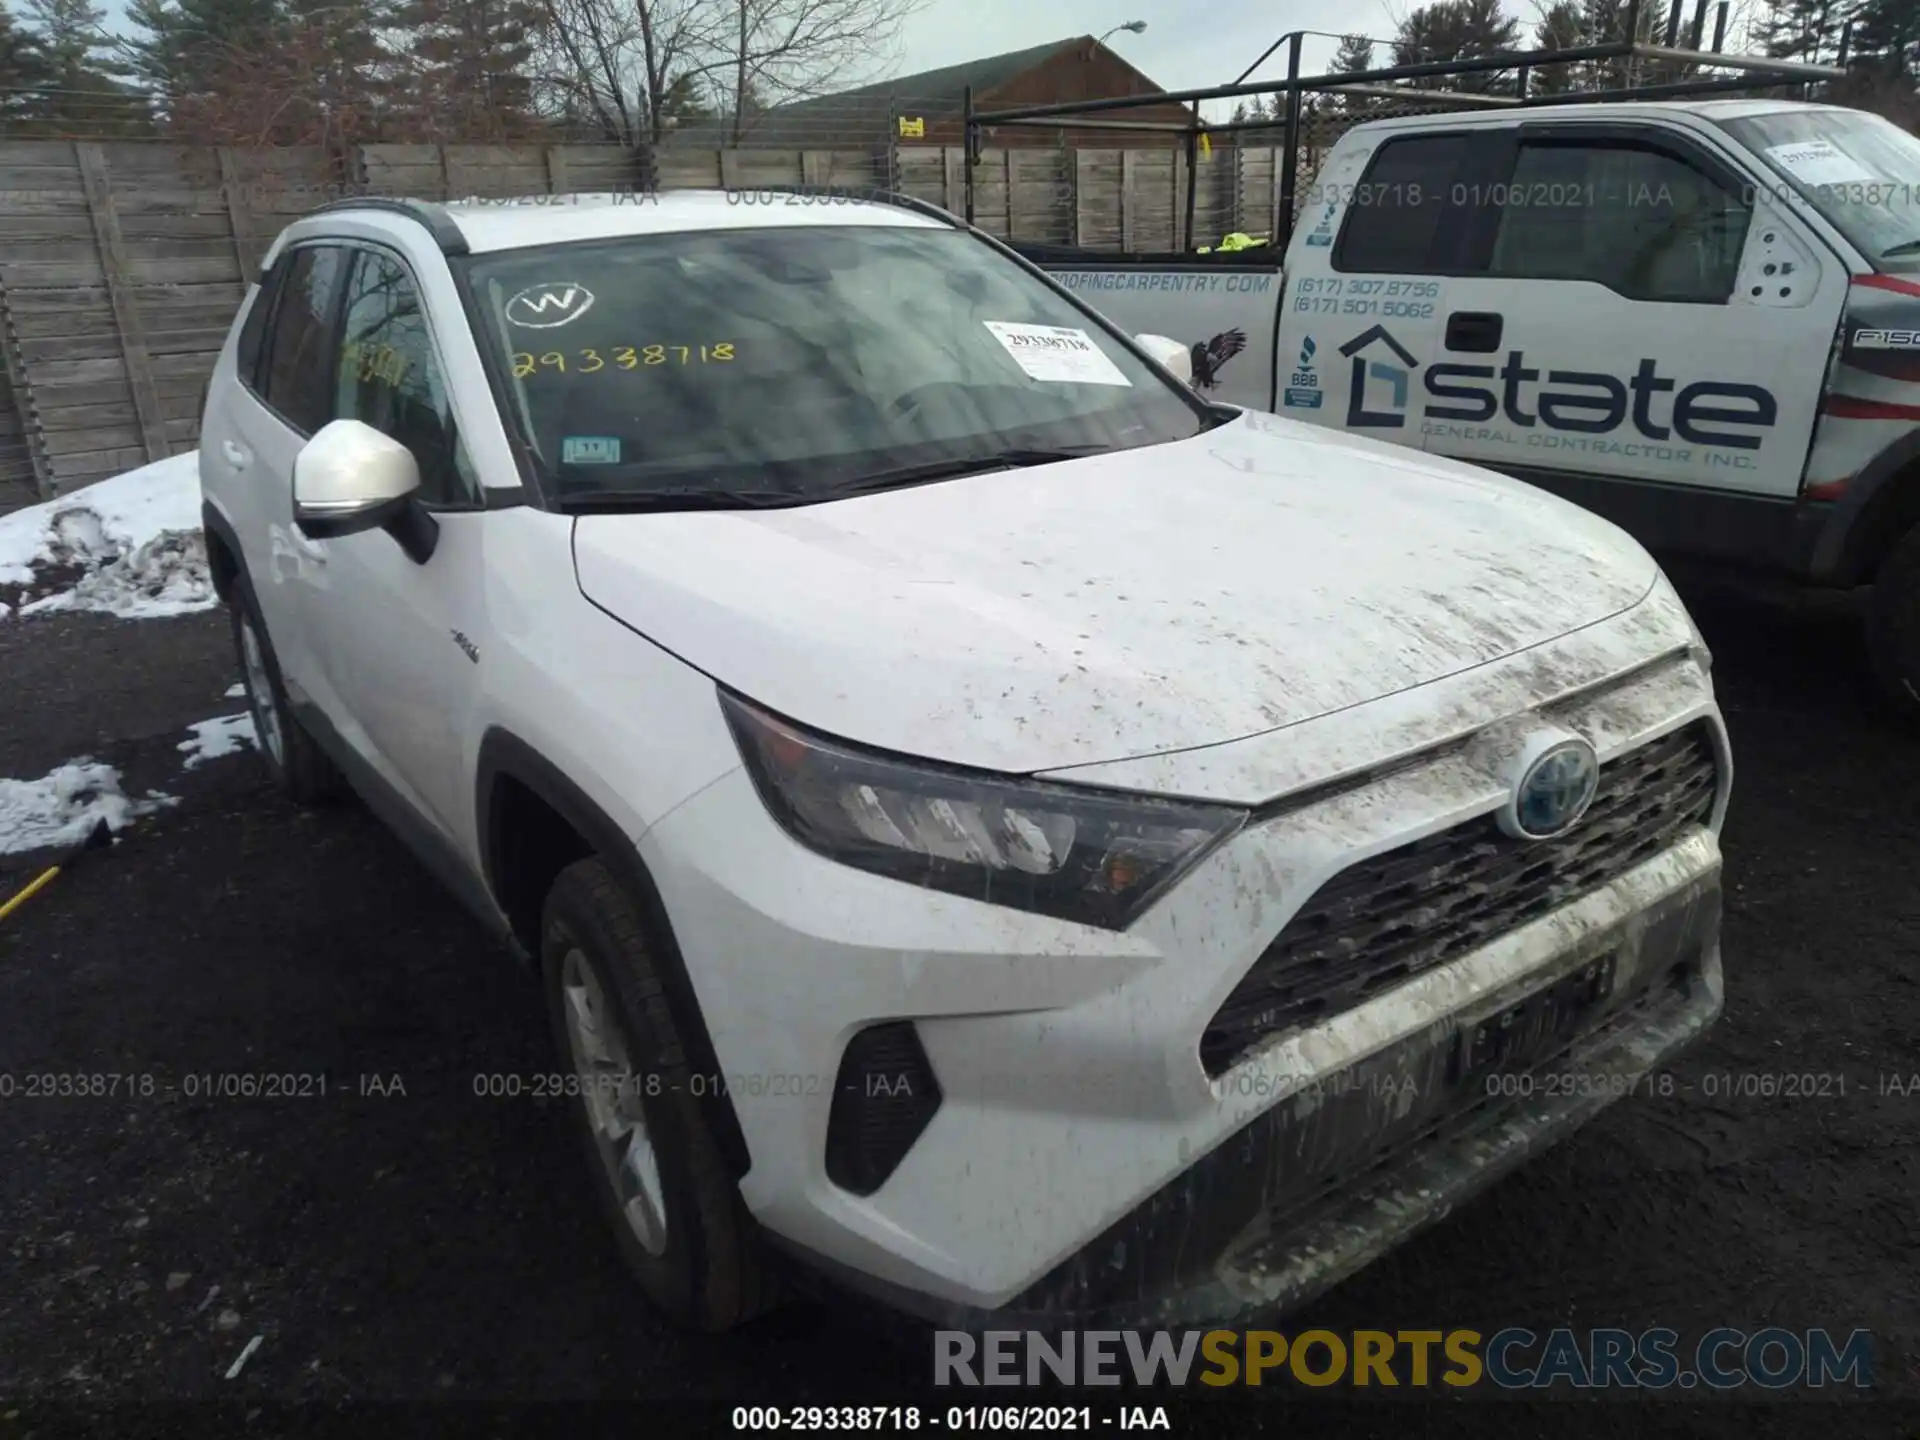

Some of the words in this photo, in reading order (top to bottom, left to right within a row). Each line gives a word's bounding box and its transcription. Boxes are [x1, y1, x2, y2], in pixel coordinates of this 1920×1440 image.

[1297, 278, 1343, 296] (617)
[521, 288, 577, 313] W
[1294, 296, 1338, 314] (617)
[511, 342, 736, 379] 29338718
[1420, 422, 1518, 446] GENERAL
[1526, 433, 1692, 464] CONTRACTOR
[1703, 451, 1758, 471] INC.
